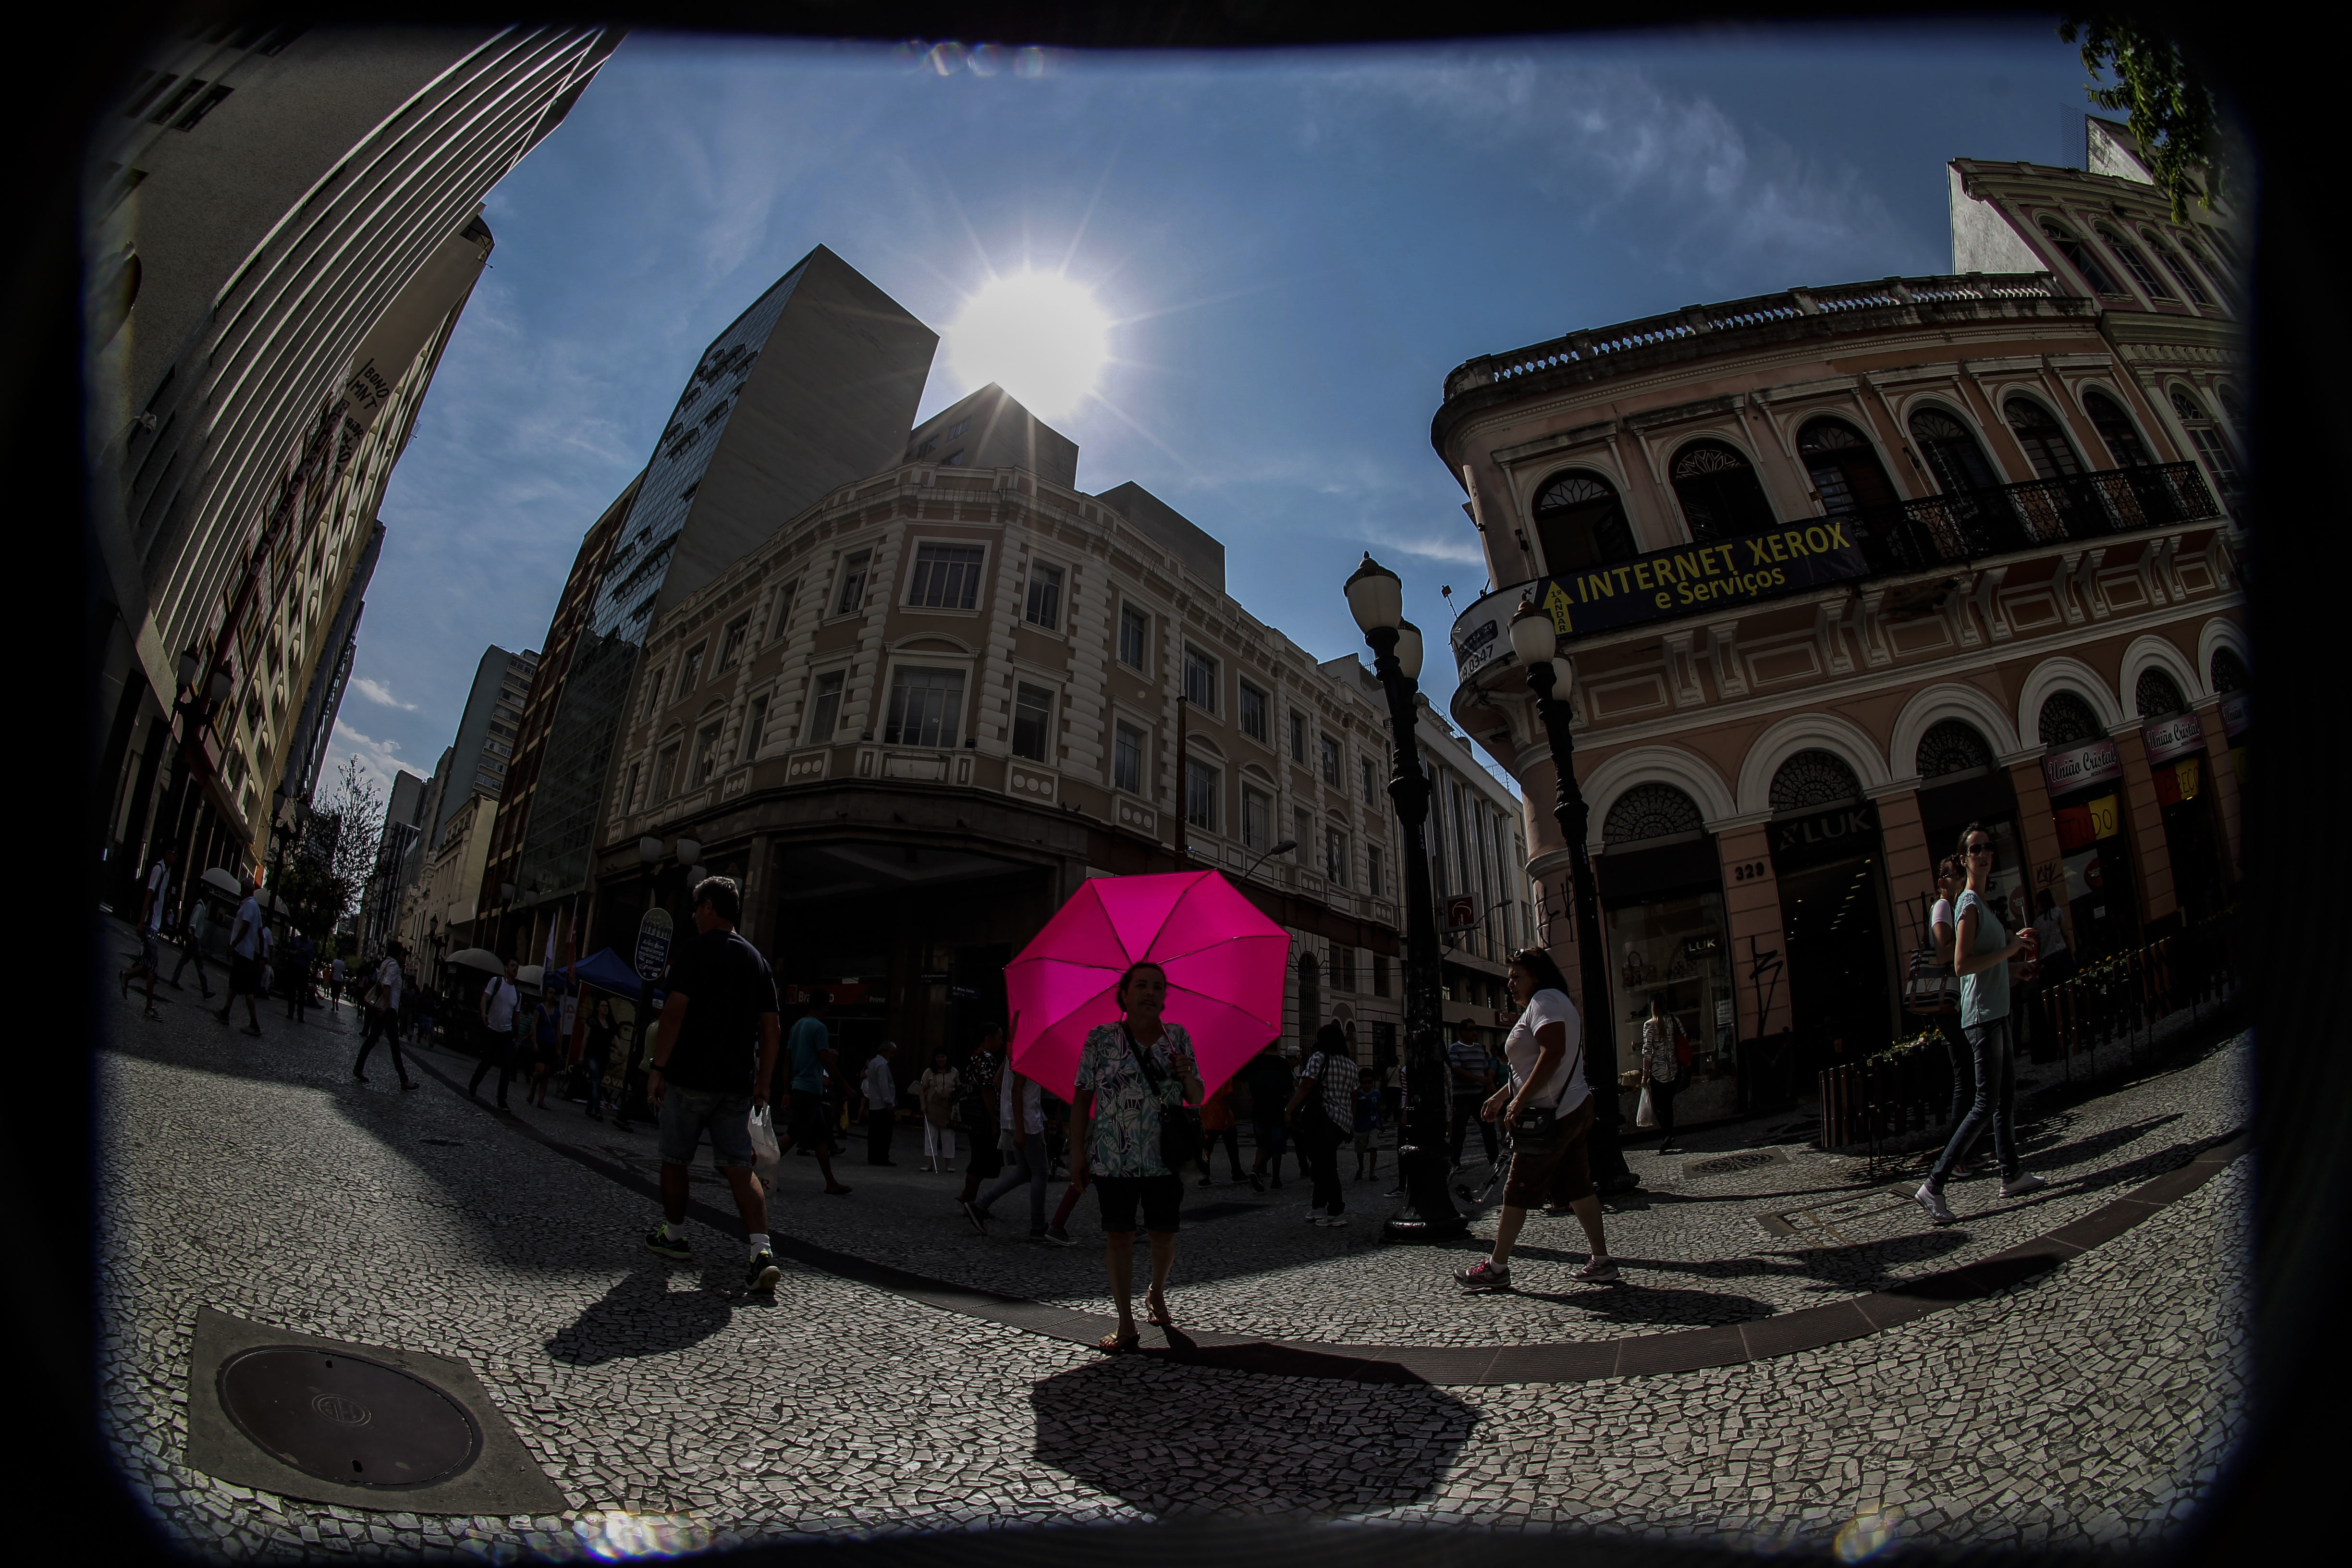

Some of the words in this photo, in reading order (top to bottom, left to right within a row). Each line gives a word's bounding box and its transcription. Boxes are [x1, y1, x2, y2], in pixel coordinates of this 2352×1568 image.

[1577, 543, 1735, 603] INTERNET
[1745, 522, 1850, 566] XEROX
[1655, 591, 1672, 610] e
[1677, 567, 1786, 605] Serviços
[1554, 598, 1567, 633] ANDAR
[2147, 730, 2173, 750] União
[2173, 717, 2200, 741] Cristal
[2048, 759, 2082, 782] União
[2082, 744, 2116, 771] Cristal
[1803, 808, 1873, 844] LUK
[2061, 809, 2112, 845] TUDO
[1735, 862, 1764, 881] 329
[213, 889, 238, 904] Senadinho
[1688, 938, 1716, 951] LUK
